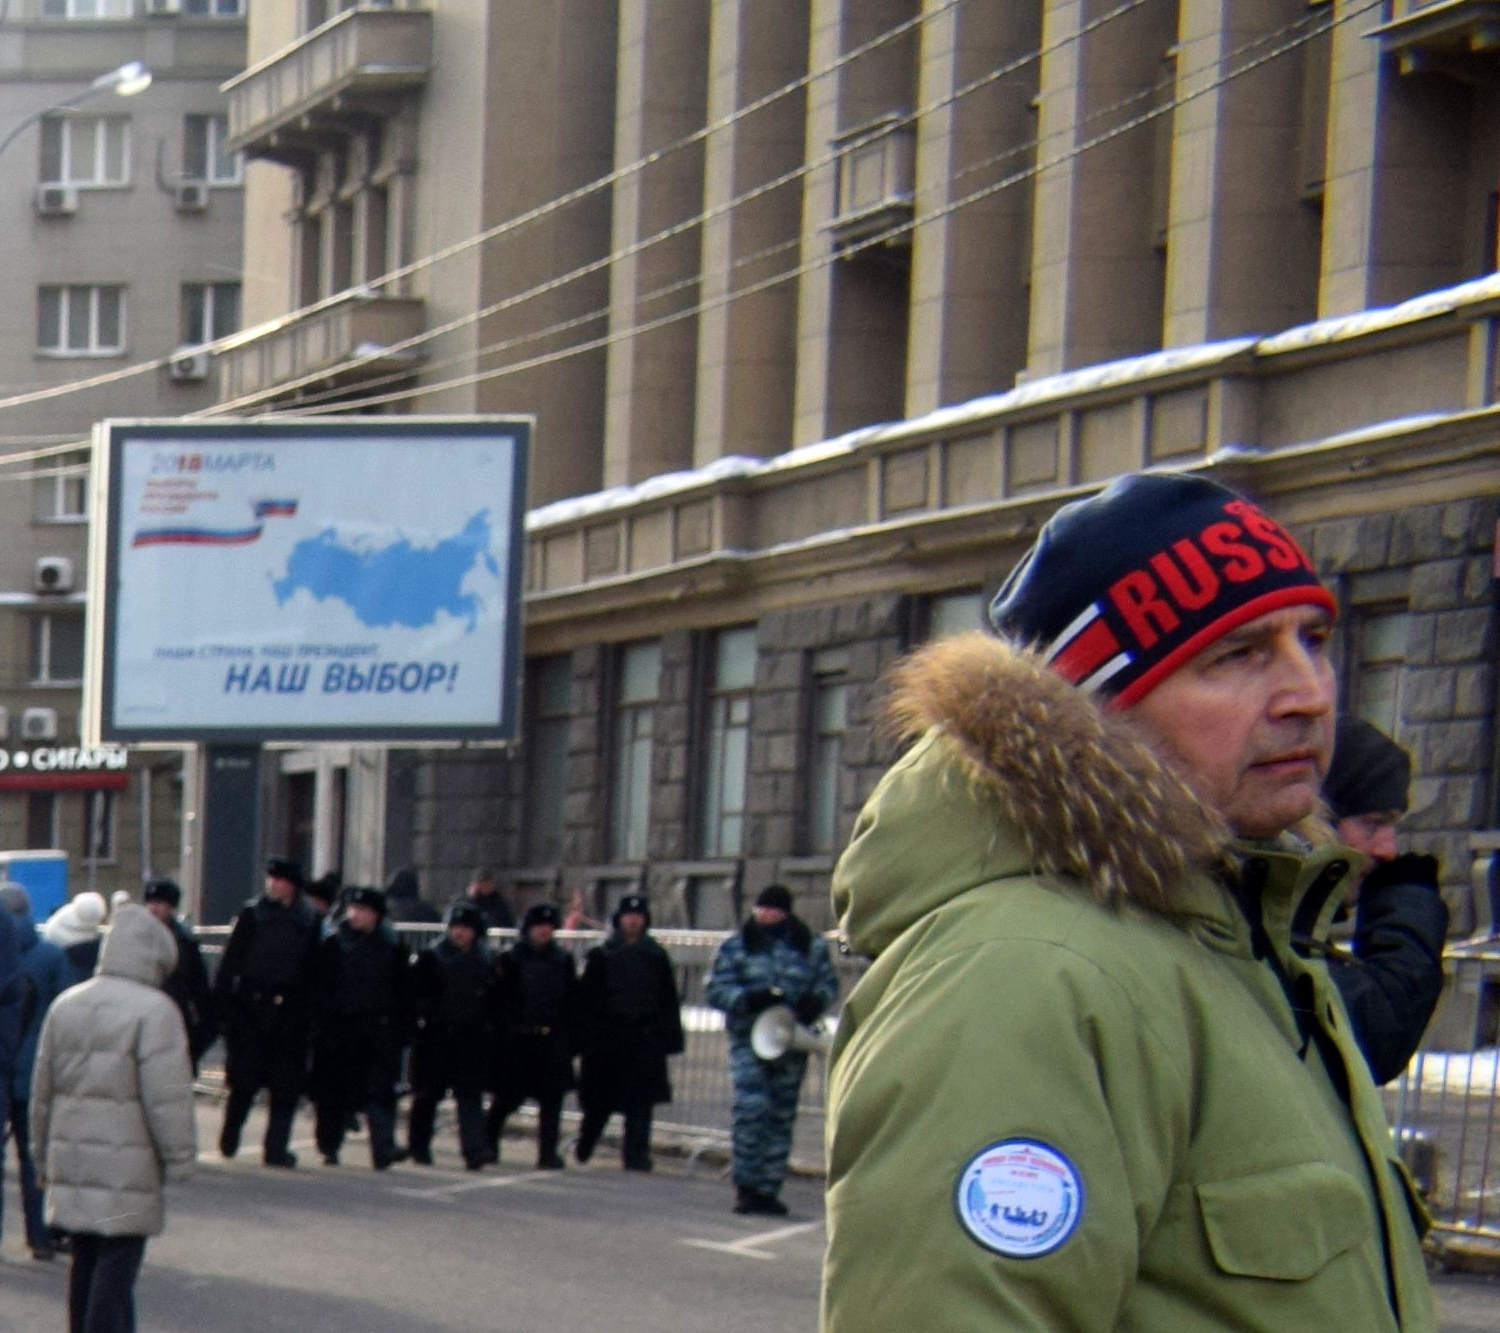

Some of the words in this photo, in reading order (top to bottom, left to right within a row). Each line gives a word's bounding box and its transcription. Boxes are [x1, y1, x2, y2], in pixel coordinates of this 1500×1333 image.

[224, 660, 312, 695] НАШ
[321, 660, 459, 695] ВЫБОР!
[31, 746, 128, 771] СИГАРЫ
